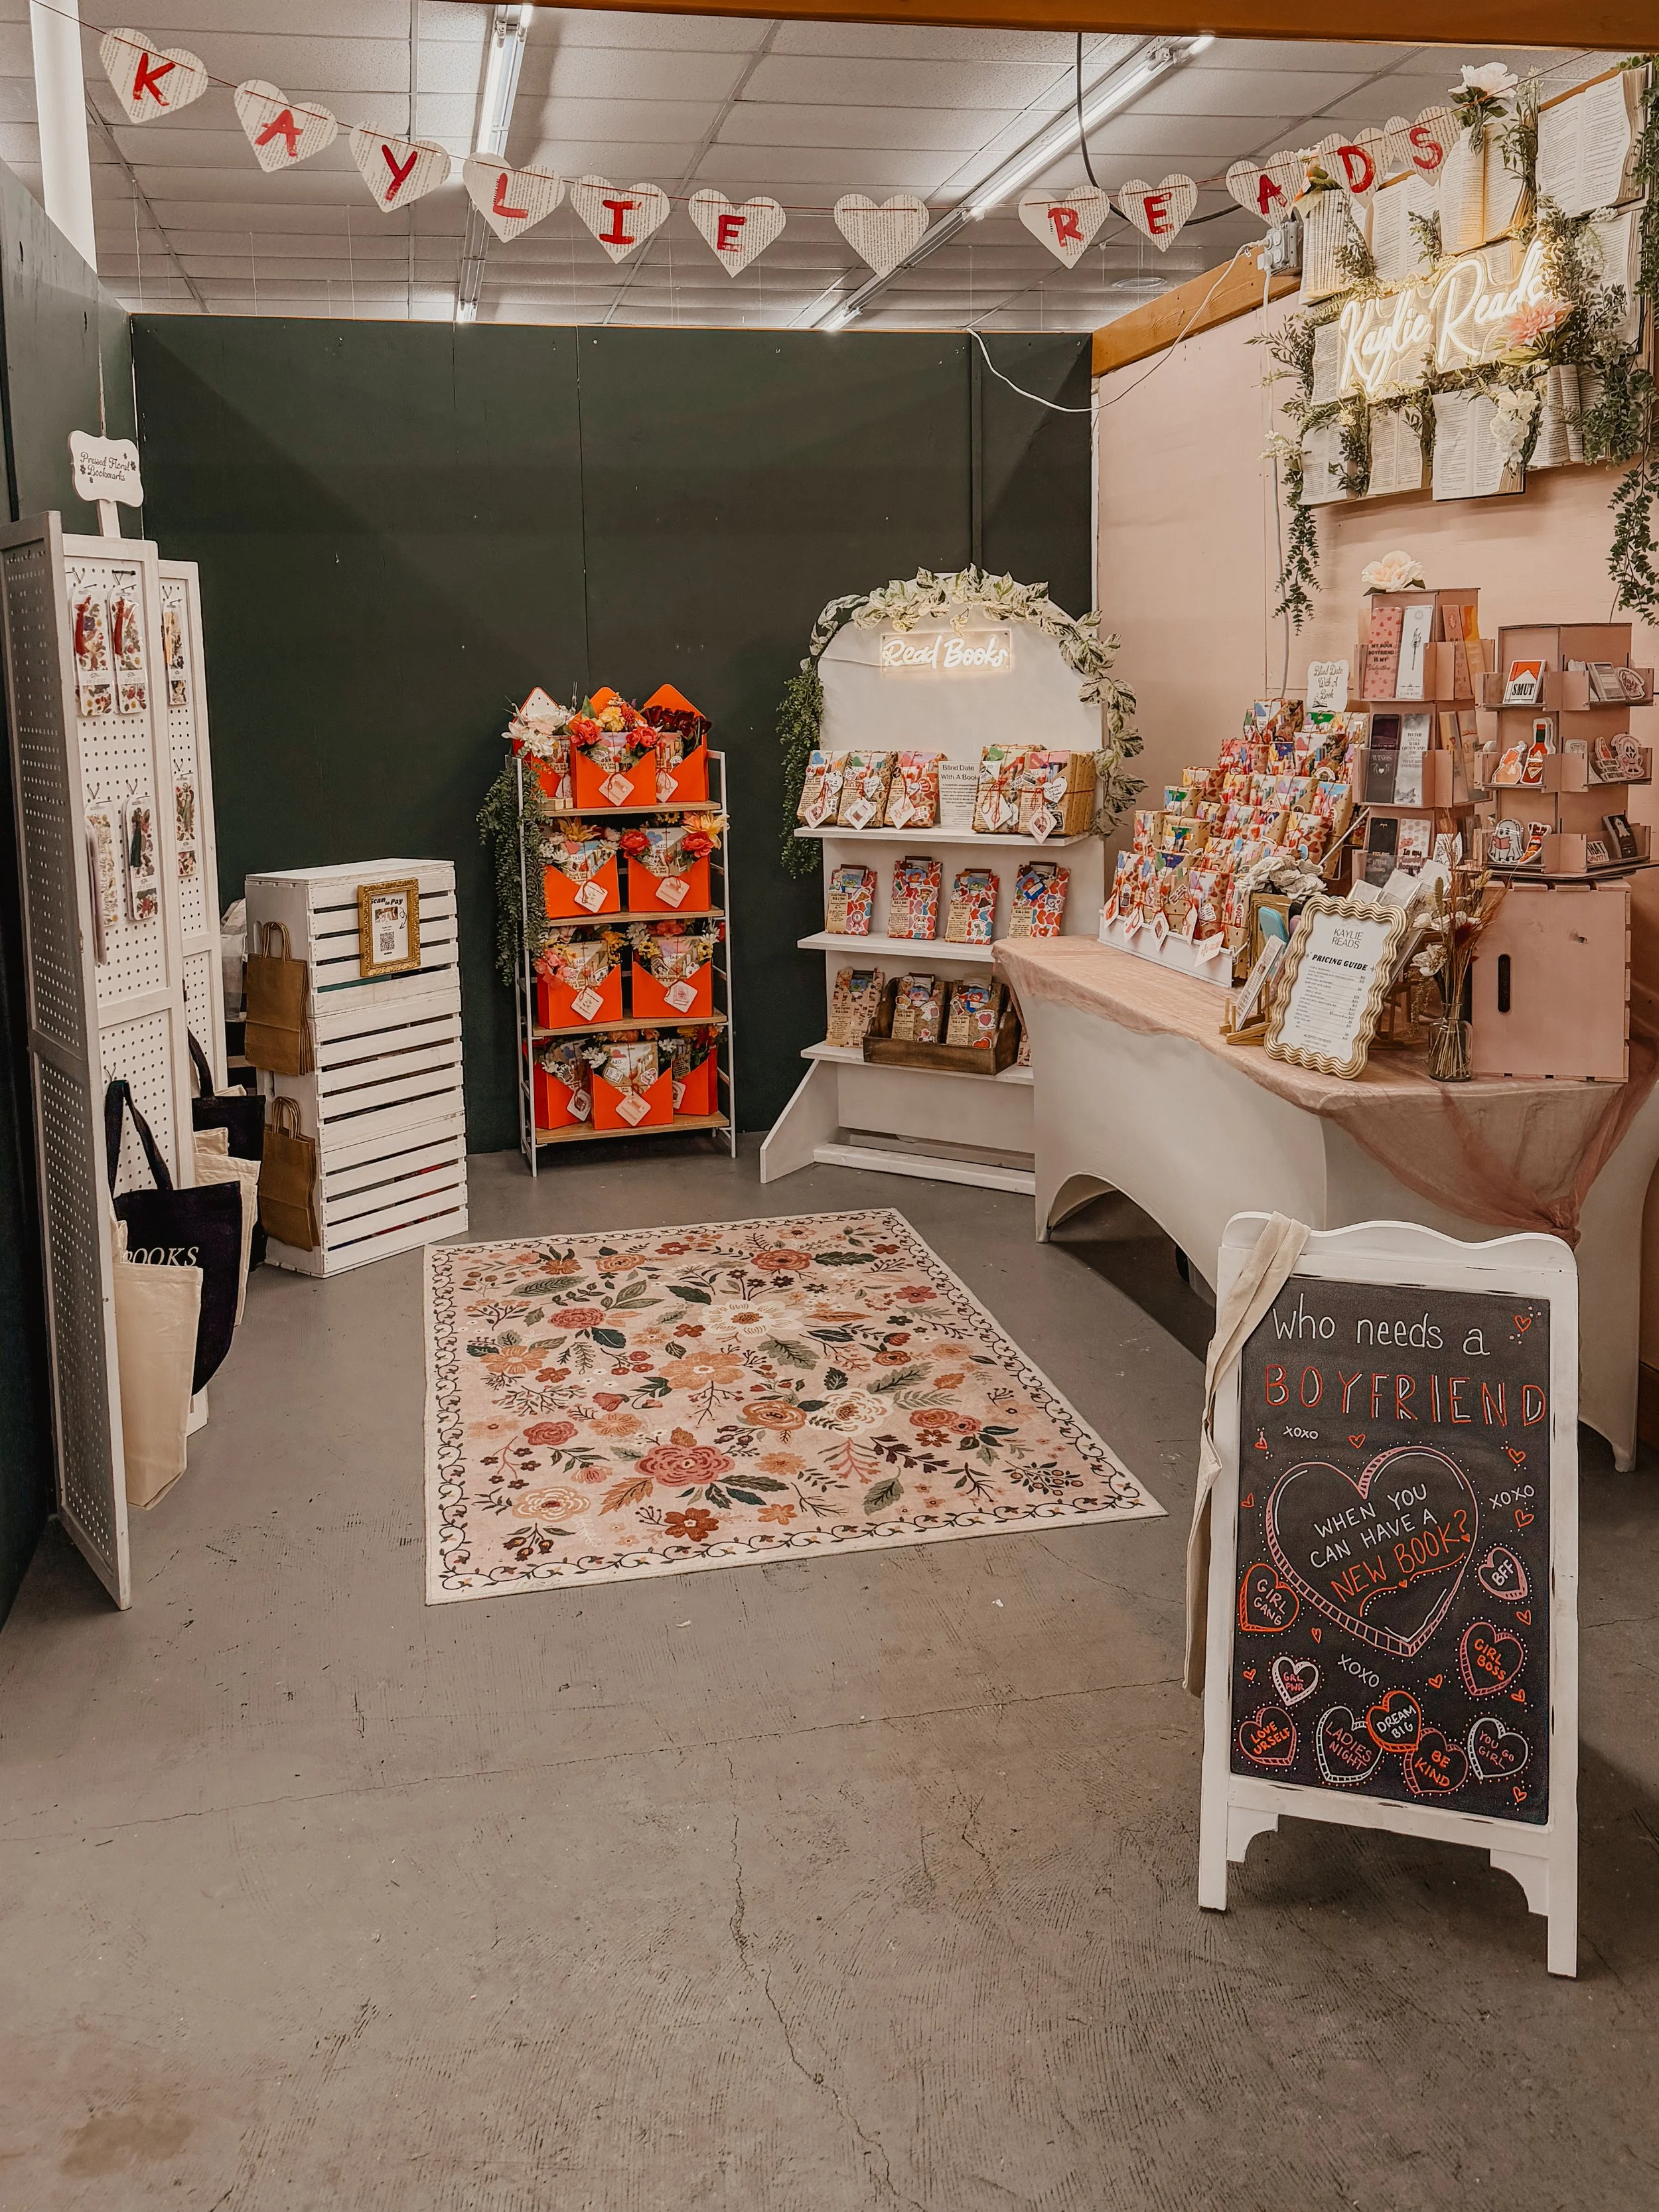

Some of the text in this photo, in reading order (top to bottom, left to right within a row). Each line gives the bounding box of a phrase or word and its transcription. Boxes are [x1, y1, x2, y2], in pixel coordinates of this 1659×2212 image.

[1340, 288, 1433, 393] Kaylie
[80, 452, 129, 471] Pressed Floral
[88, 465, 125, 481] Bookmarks
[882, 635, 1008, 669] Read Books
[1314, 664, 1343, 677] Blind Date
[1318, 676, 1338, 688] With A
[1320, 688, 1334, 700] Book
[1512, 684, 1536, 696] SMUT
[1331, 936, 1360, 949] READS
[1333, 928, 1364, 941] KAYLIE
[1311, 954, 1368, 971] PRICING GUIDE
[1356, 1313, 1443, 1349] needs
[1463, 1327, 1491, 1356] a
[1265, 1364, 1546, 1427] BOYFRIEND
[1314, 1483, 1427, 1538] WHEN YOU
[1309, 1508, 1438, 1568] CAN HAVE A
[1331, 1509, 1472, 1603] NEW BOOK?
[1491, 1559, 1515, 1587] BFF
[1256, 1578, 1286, 1614] GIRL
[1252, 1595, 1283, 1626] GANG
[1473, 1638, 1502, 1666] GIRL
[1283, 1671, 1305, 1683] GRL
[1476, 1654, 1506, 1681] BOSS
[1285, 1681, 1306, 1692] PWR
[1376, 1704, 1417, 1733] DREAM
[1391, 1722, 1415, 1740] BIG
[1250, 1721, 1278, 1745] LOVE
[1252, 1727, 1291, 1755] URSELF
[1325, 1720, 1373, 1763] LADIES
[1329, 1739, 1368, 1772] NIGHT
[1430, 1749, 1452, 1767] BE
[1478, 1745, 1506, 1769] GIRL
[1479, 1732, 1516, 1763] YOU GO
[1414, 1756, 1451, 1788] KIND
